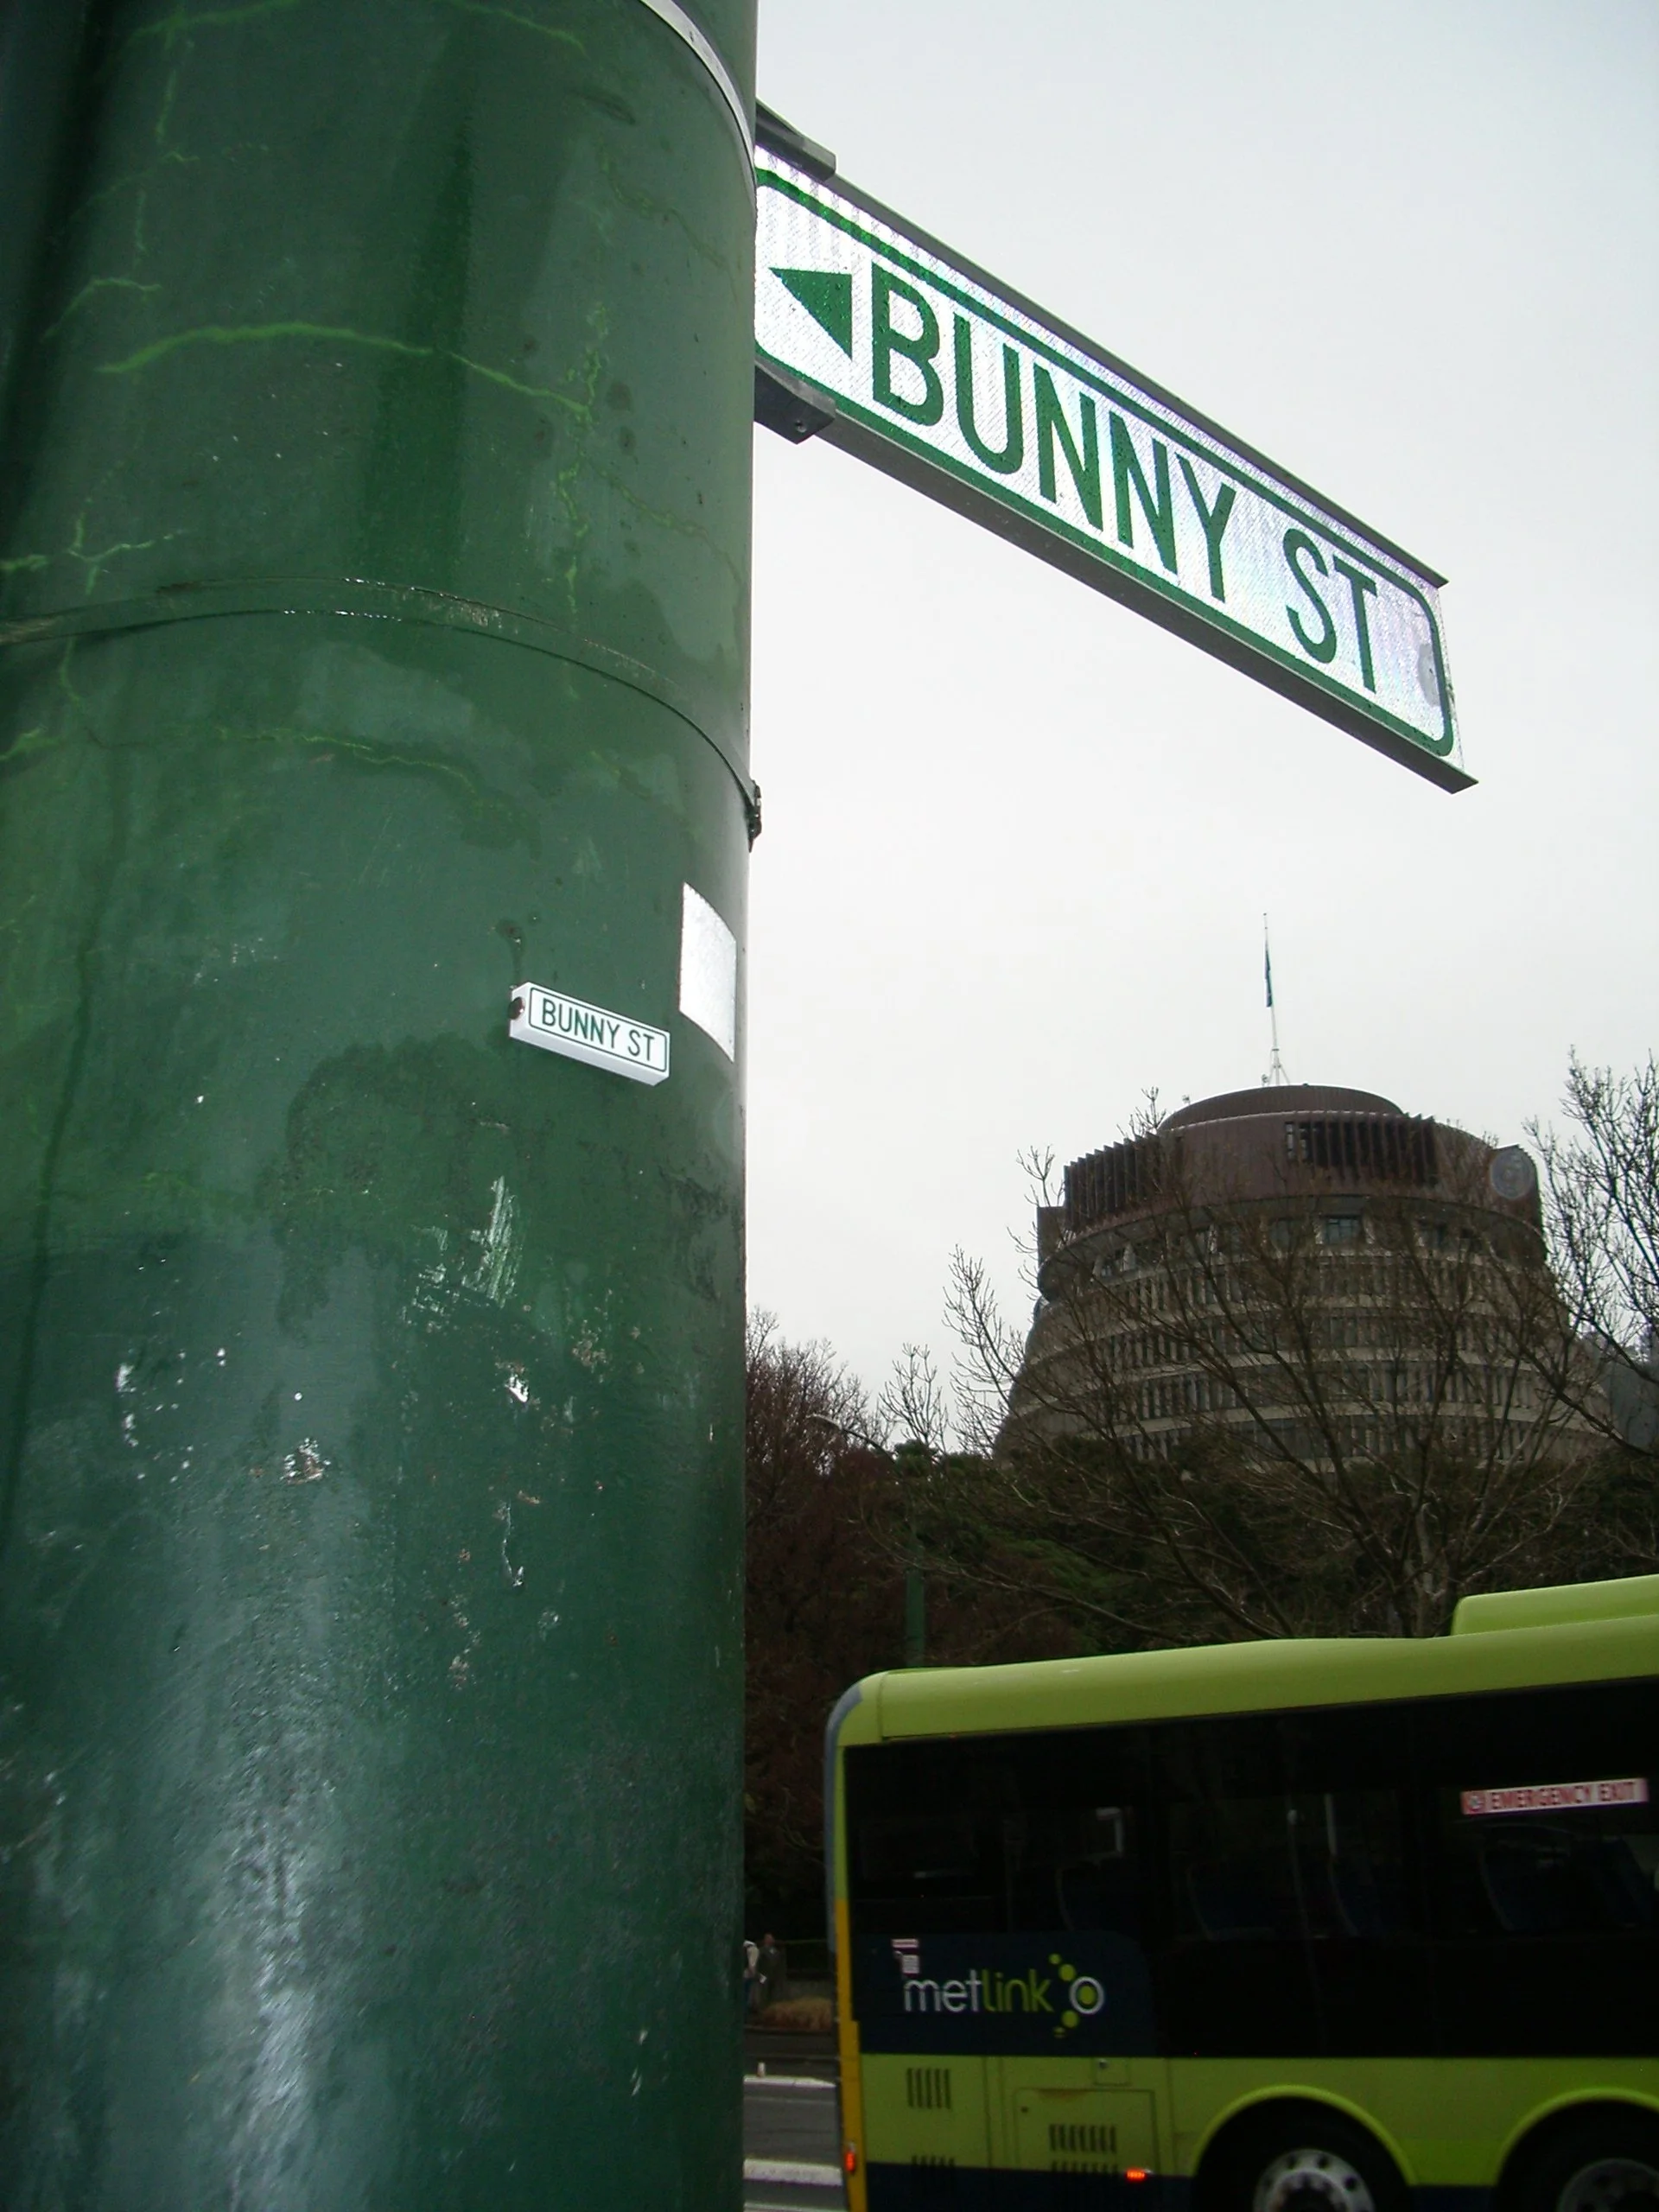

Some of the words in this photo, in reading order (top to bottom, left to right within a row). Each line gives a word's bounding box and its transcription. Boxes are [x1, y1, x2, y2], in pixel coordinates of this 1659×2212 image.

[871, 262, 1236, 603] BUNNY
[1282, 528, 1377, 693] ST
[542, 998, 620, 1049] BUNNY
[628, 1030, 655, 1061] ST
[1491, 1785, 1592, 1809] EMERGENCY
[1600, 1781, 1635, 1802] EXIT
[904, 1969, 1054, 2012] metlink
